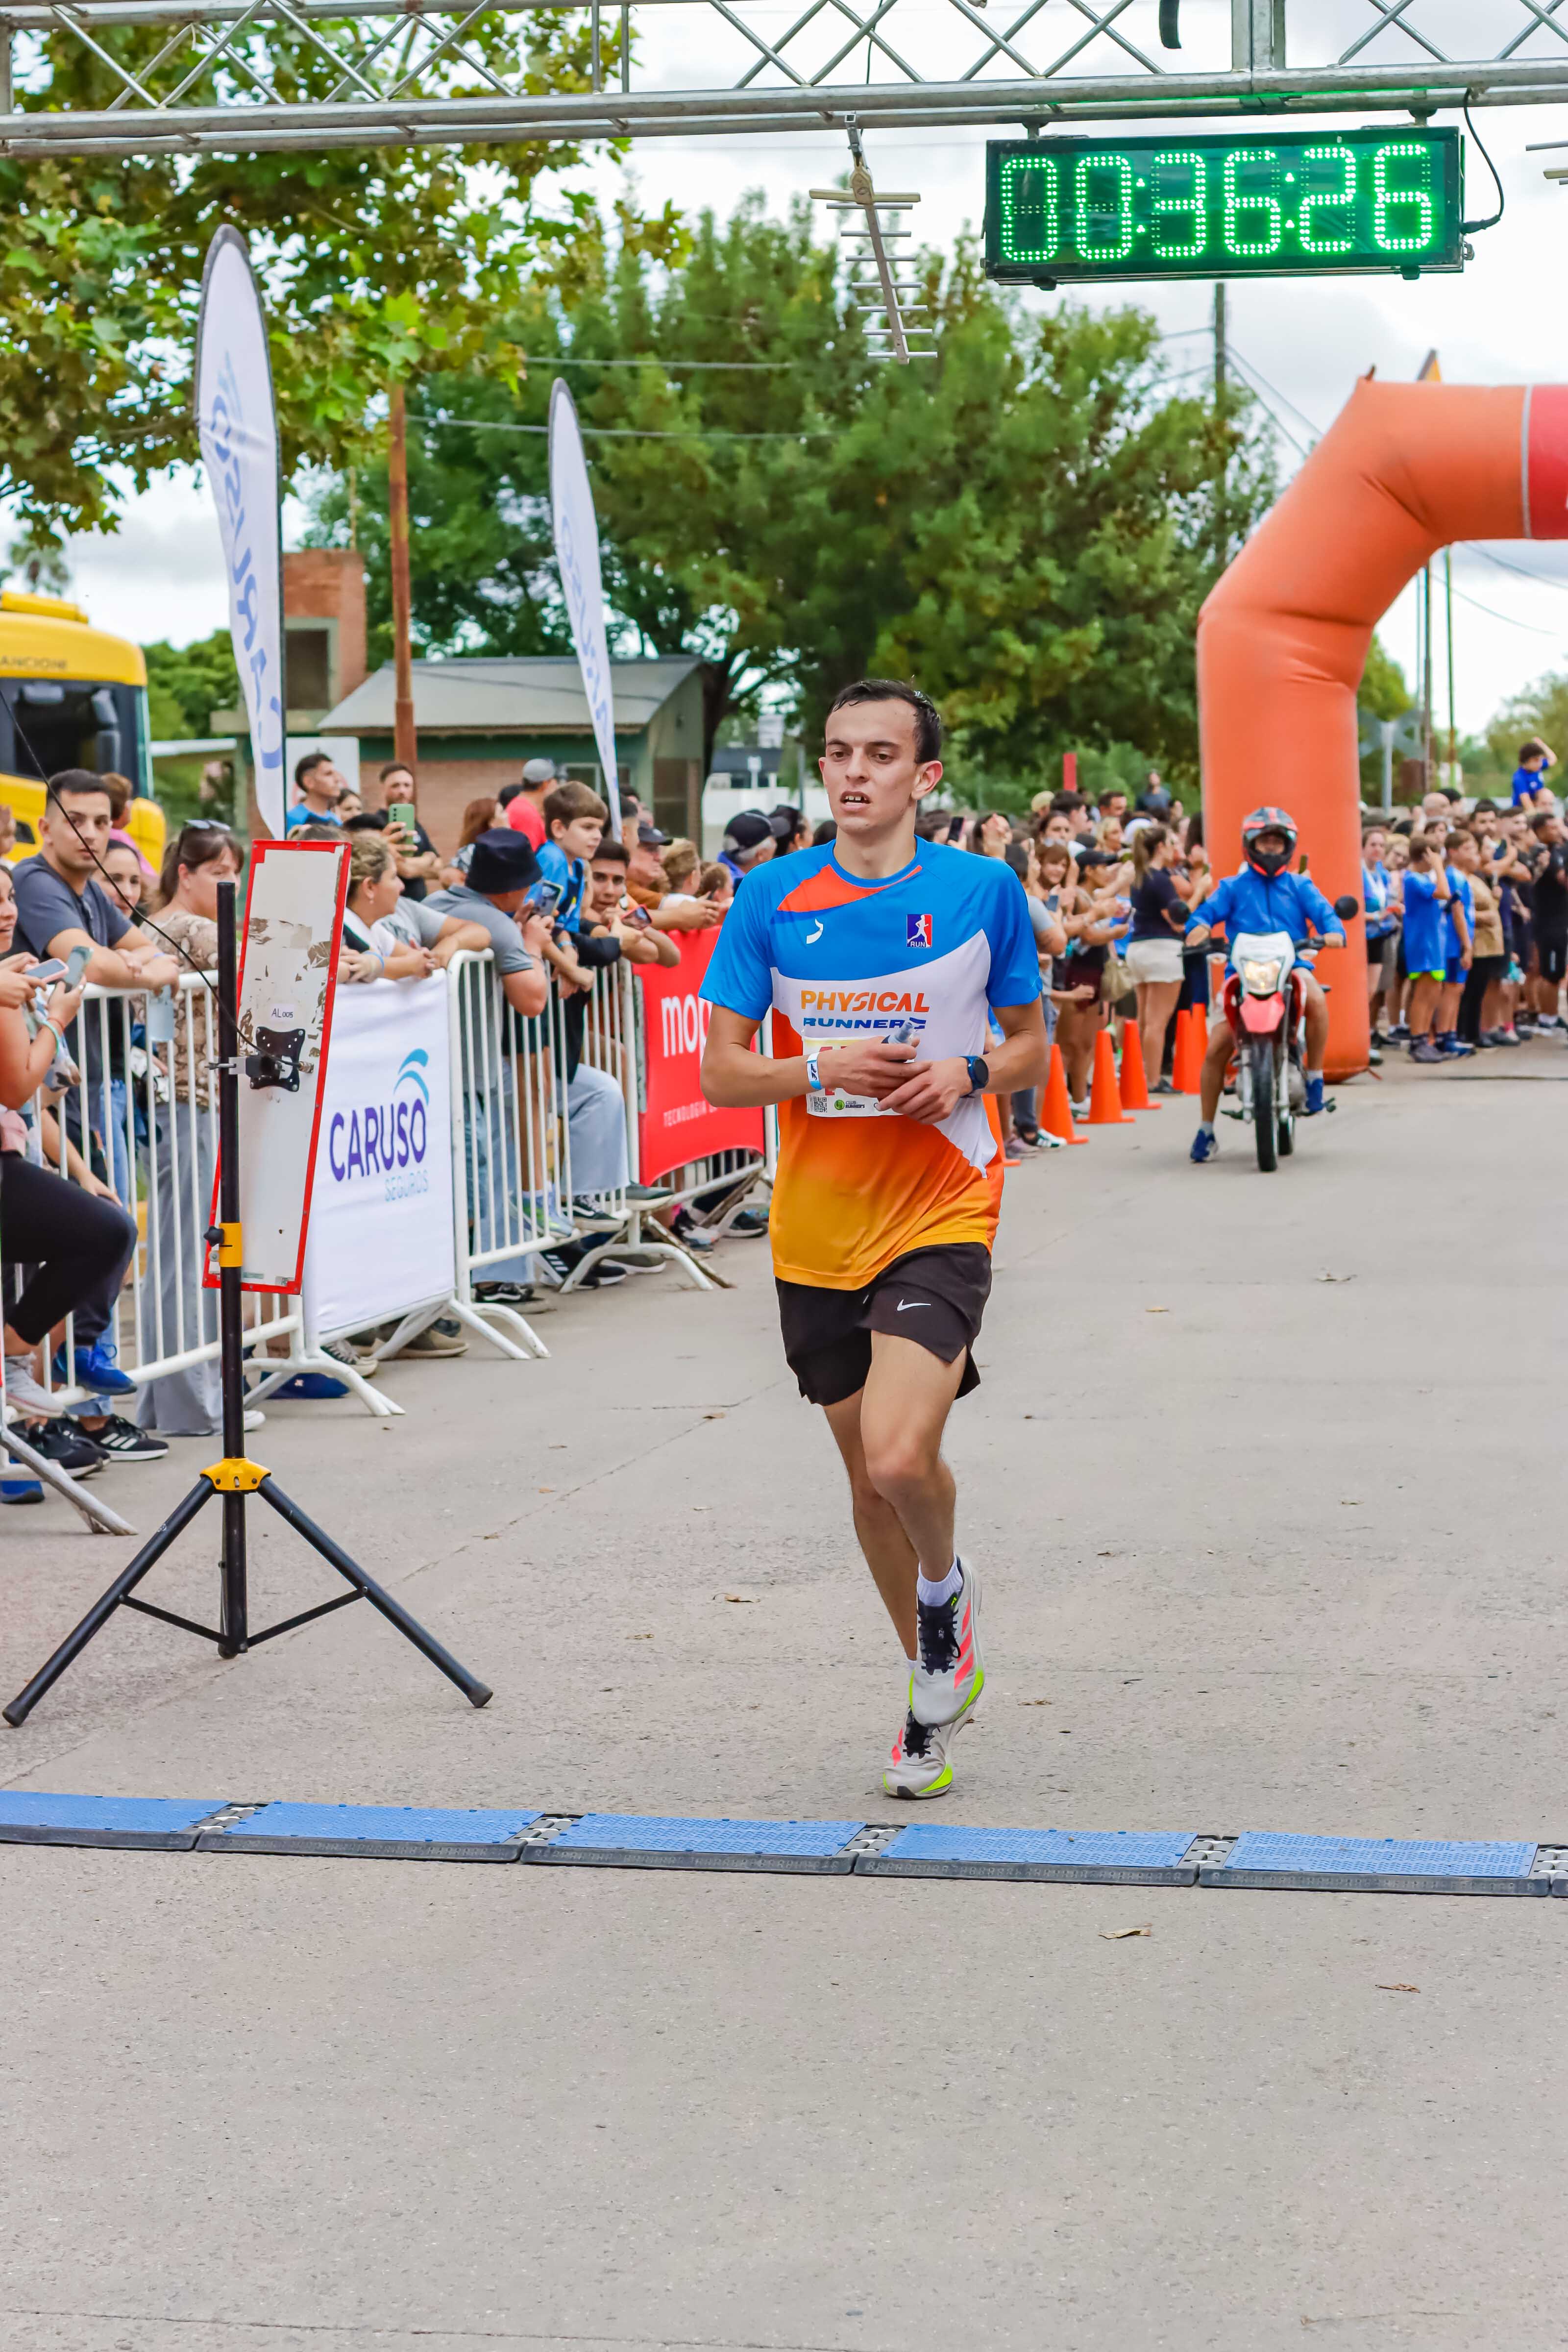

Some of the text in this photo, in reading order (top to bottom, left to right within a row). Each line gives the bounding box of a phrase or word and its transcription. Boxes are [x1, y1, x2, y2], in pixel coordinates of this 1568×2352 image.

[1001, 144, 1432, 262] 00:36:26
[801, 990, 930, 1012] PHYSICAL
[329, 1098, 426, 1182] CARUSO
